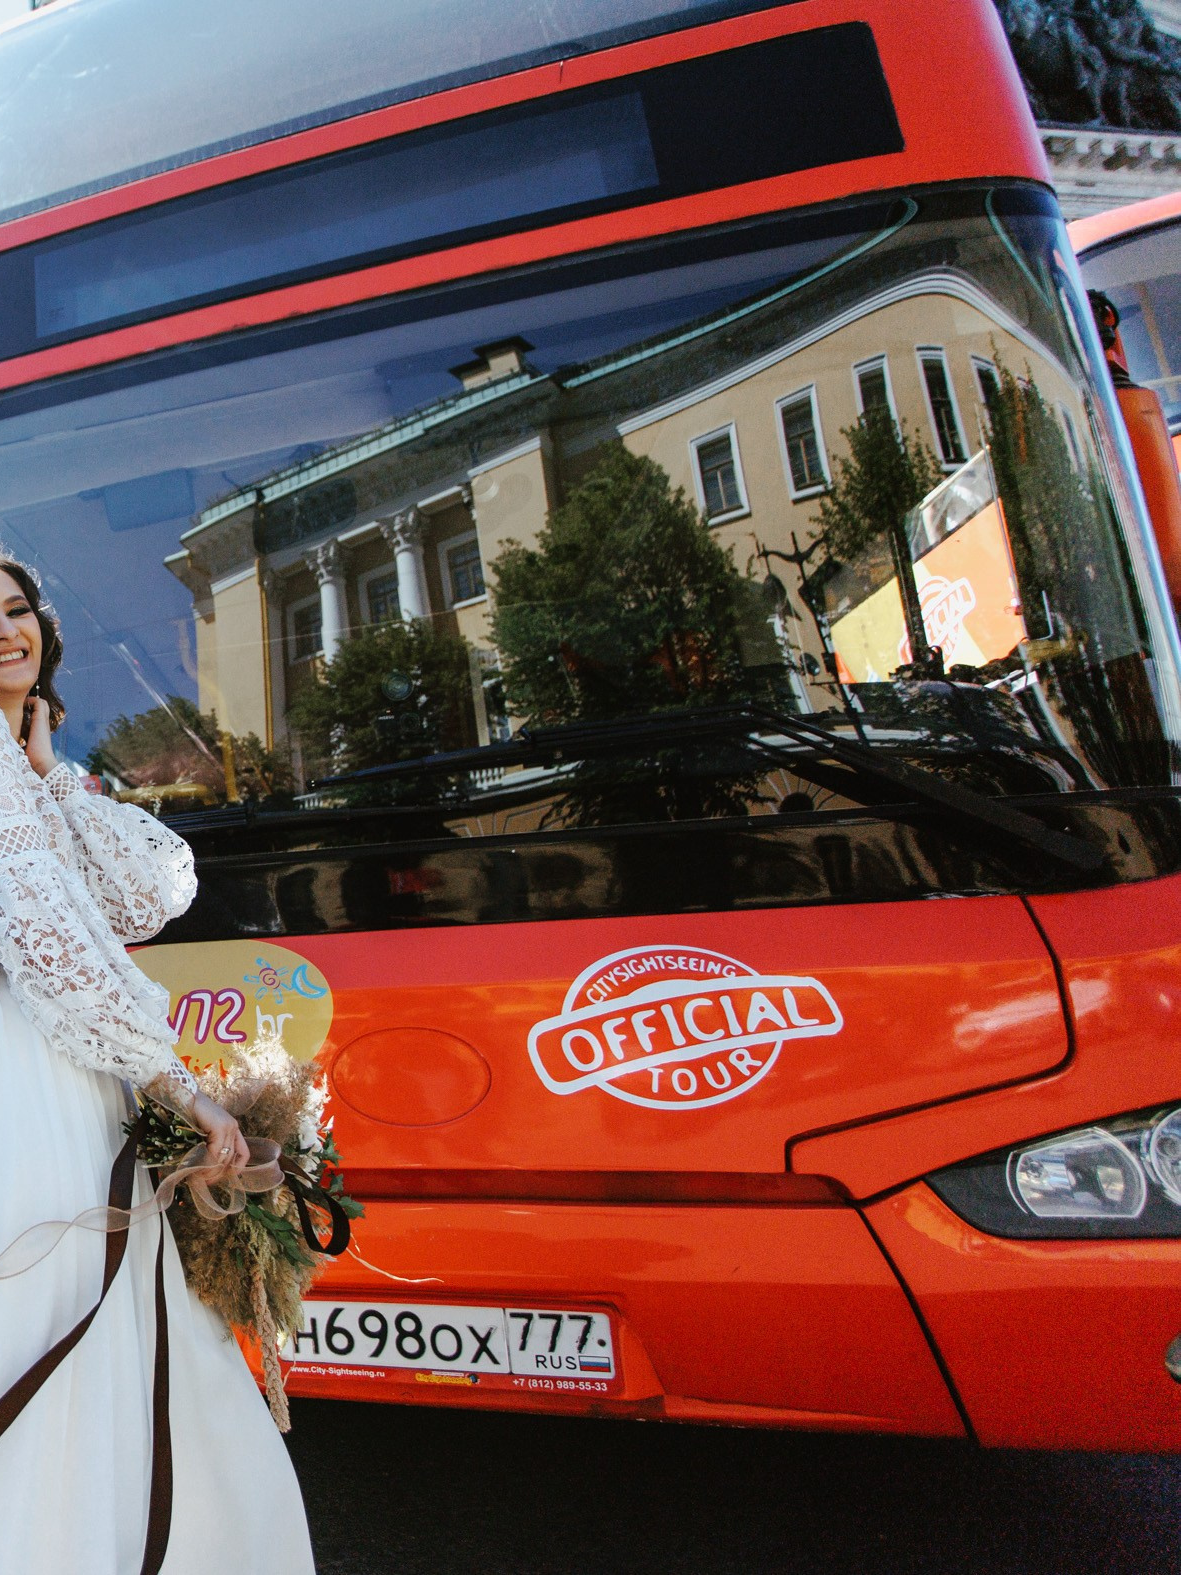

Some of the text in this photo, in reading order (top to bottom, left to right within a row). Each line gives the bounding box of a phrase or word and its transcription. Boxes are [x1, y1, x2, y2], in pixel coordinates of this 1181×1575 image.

[586, 955, 737, 1004] CITYSIGHTSEEING
[561, 987, 820, 1073] OFFICIAL
[647, 1048, 763, 1096] TOUR
[512, 1379, 608, 1392] +7 (812) 989-55-33
[535, 1355, 577, 1370] RUS
